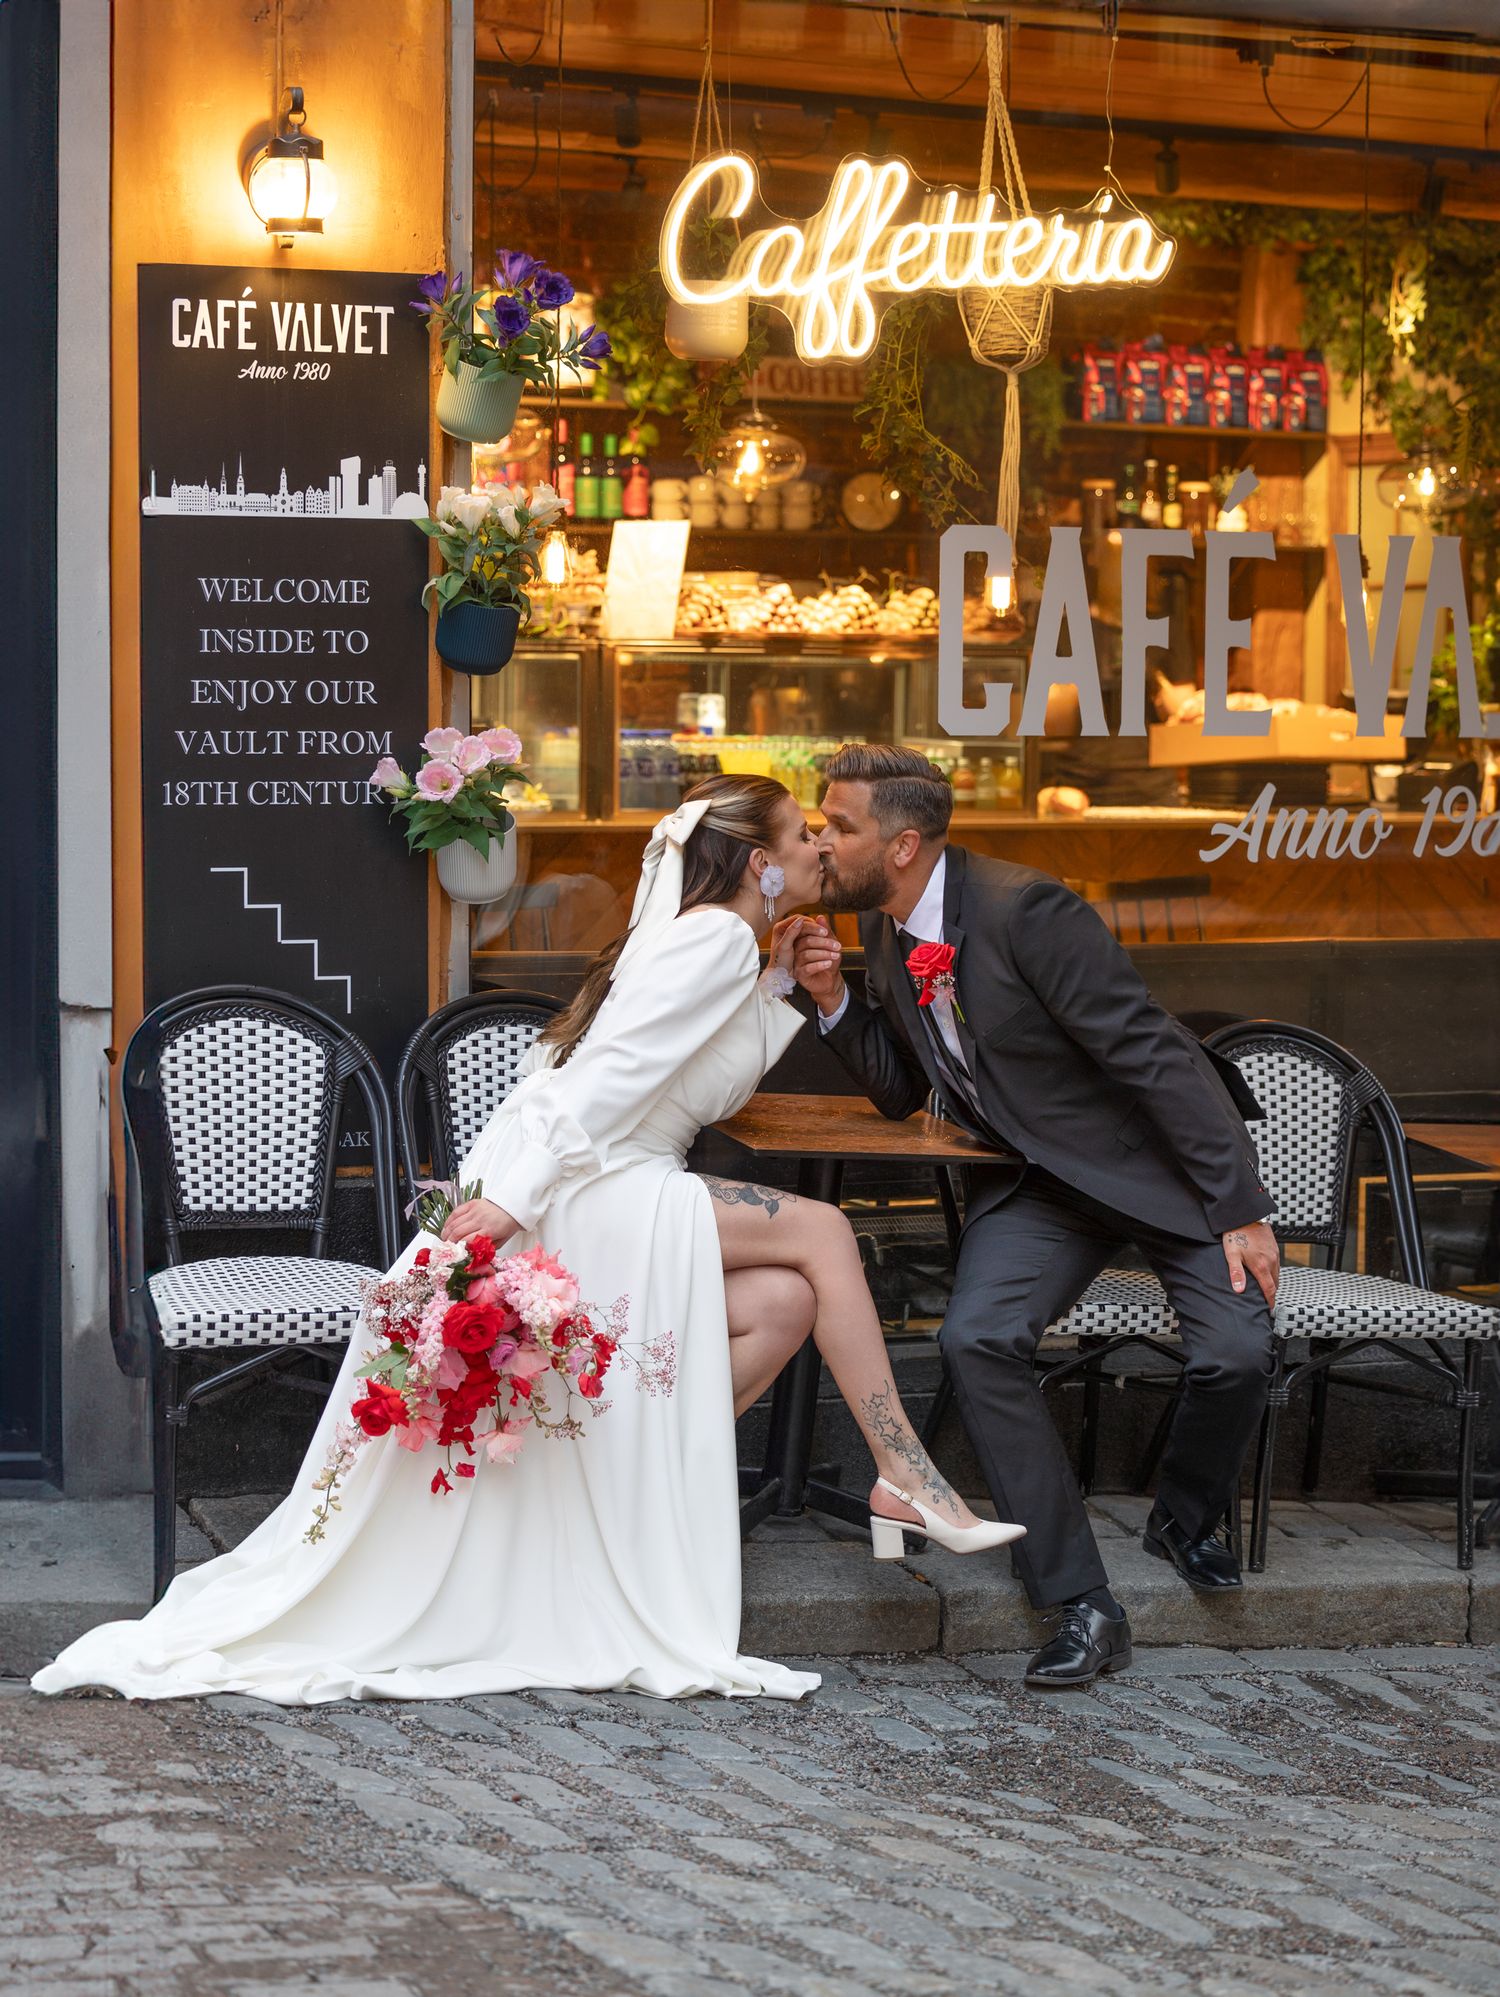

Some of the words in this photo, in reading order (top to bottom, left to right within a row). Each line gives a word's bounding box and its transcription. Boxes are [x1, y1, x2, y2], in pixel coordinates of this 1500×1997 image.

[666, 156, 1174, 359] Caffetteria
[172, 286, 257, 350] CAFÉ
[270, 301, 395, 354] VALVET
[237, 359, 289, 380] Anno
[292, 361, 332, 381] 1980
[197, 577, 371, 604] WELCOME
[938, 465, 1277, 737] CAFÉ
[1332, 534, 1500, 739] VA
[199, 628, 315, 654] INSIDE
[322, 629, 370, 655] TO
[190, 679, 298, 712] ENJOY
[304, 680, 378, 705] OUR
[174, 730, 289, 755] VAULT
[296, 730, 393, 755] FROM
[162, 780, 239, 806] 18TH
[246, 780, 399, 806] CENTUR
[1198, 781, 1394, 864] Anno
